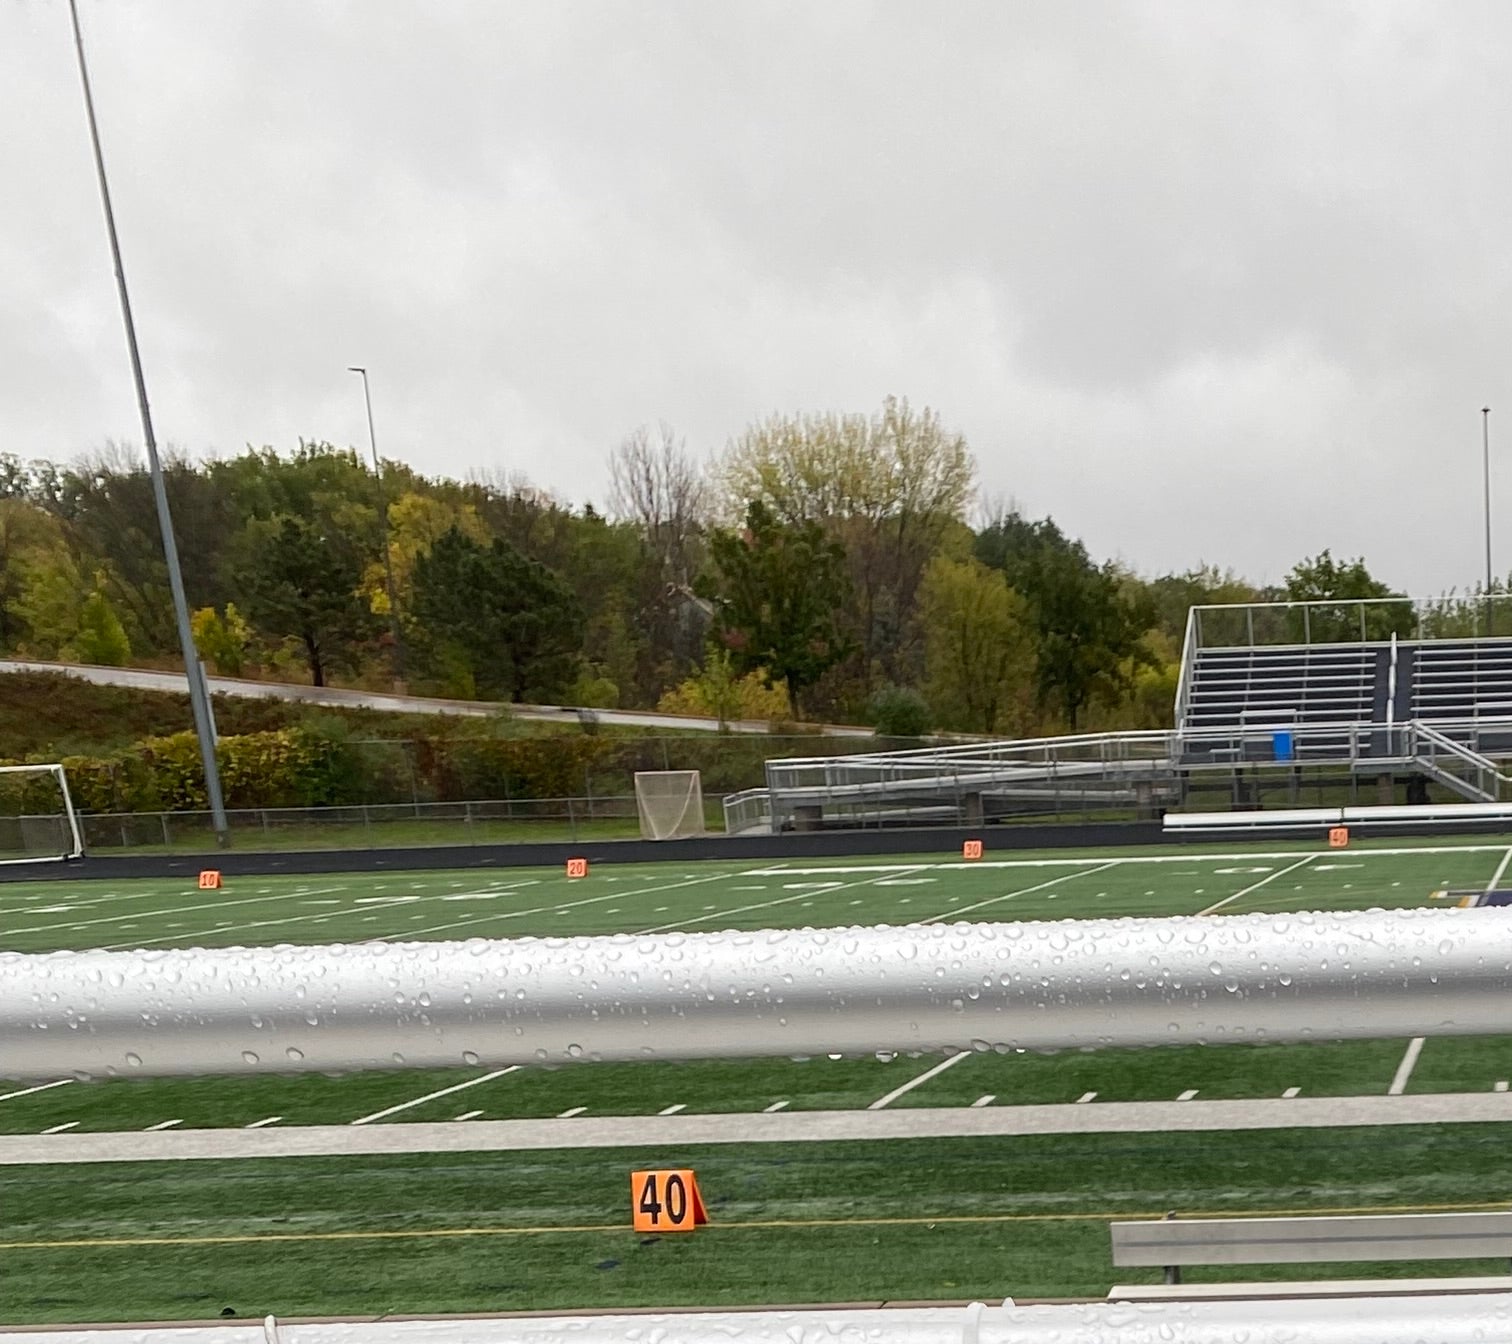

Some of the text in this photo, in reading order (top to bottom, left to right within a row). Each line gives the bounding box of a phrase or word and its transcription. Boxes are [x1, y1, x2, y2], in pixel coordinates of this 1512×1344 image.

[570, 860, 583, 874] 20
[202, 872, 216, 886] 10
[640, 1174, 686, 1224] 40
